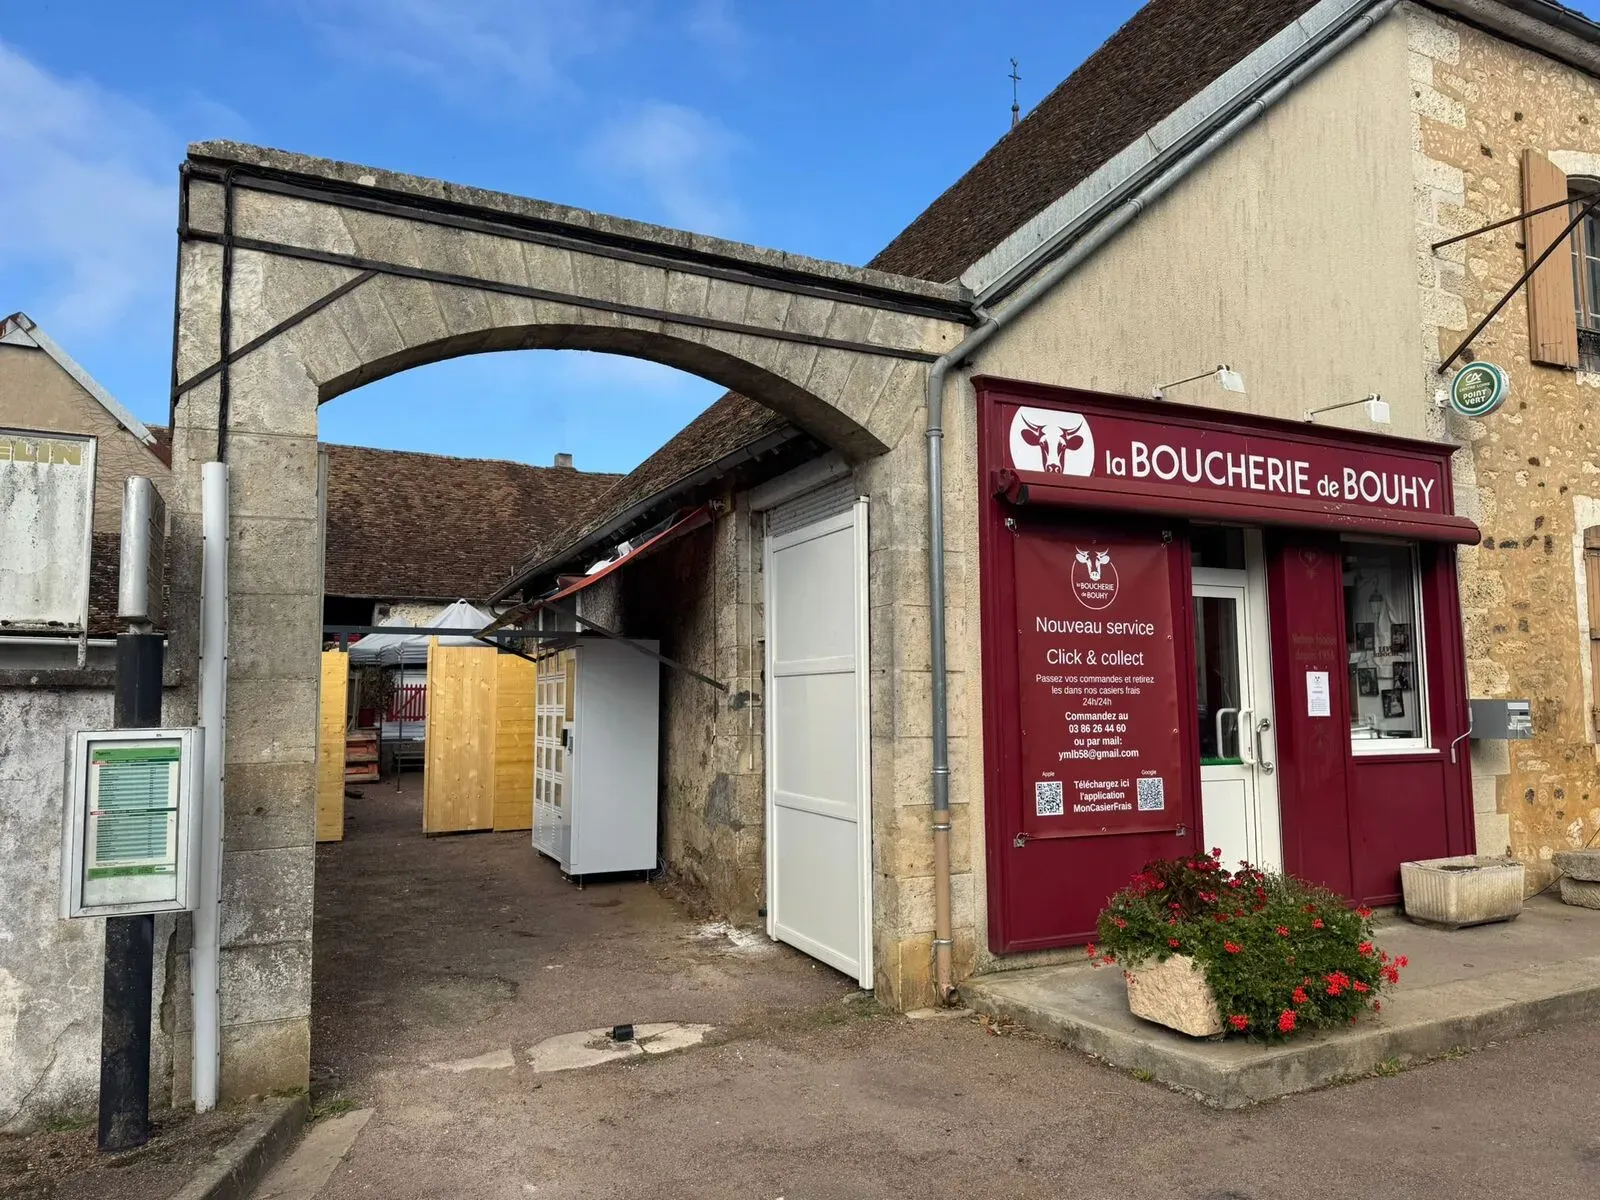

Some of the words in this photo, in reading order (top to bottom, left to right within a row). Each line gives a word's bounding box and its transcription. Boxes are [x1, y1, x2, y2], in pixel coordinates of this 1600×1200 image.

[1105, 449, 1126, 477] la
[1132, 441, 1311, 496] BOUCHERIE
[1317, 478, 1340, 498] de
[1344, 466, 1436, 510] BOUHY
[1081, 582, 1114, 591] BOUCHERIE
[1087, 591, 1109, 599] BOUHY
[1036, 616, 1102, 634] Nouveau
[1106, 619, 1154, 635] service
[1046, 648, 1082, 665] Click
[1086, 650, 1097, 665] &
[1101, 650, 1144, 666] collect
[1035, 674, 1063, 683] Passez
[1065, 675, 1078, 683] vos
[1079, 675, 1123, 684] commandes
[1124, 675, 1132, 683] et
[1132, 675, 1155, 684] retirez
[1051, 685, 1063, 695] les
[1064, 685, 1083, 695] dans
[1083, 687, 1098, 695] nos
[1099, 686, 1124, 695] casiers
[1125, 685, 1141, 695] frais
[1082, 697, 1112, 706] 24h/24h
[1065, 711, 1117, 721] Commandez
[1118, 712, 1129, 720] au
[1068, 724, 1079, 733] 03
[1080, 724, 1091, 733] 86
[1092, 724, 1103, 733] 26
[1104, 724, 1115, 733] 44
[1116, 723, 1126, 733] 60
[1073, 738, 1085, 746] ou
[1087, 738, 1100, 747] par
[1058, 748, 1139, 761] ymlb58@gmail.com
[1073, 779, 1118, 790] Téléchargez
[1120, 778, 1130, 787] ici
[1080, 791, 1125, 802] l'application
[1073, 801, 1133, 812] MonCasierFrais
